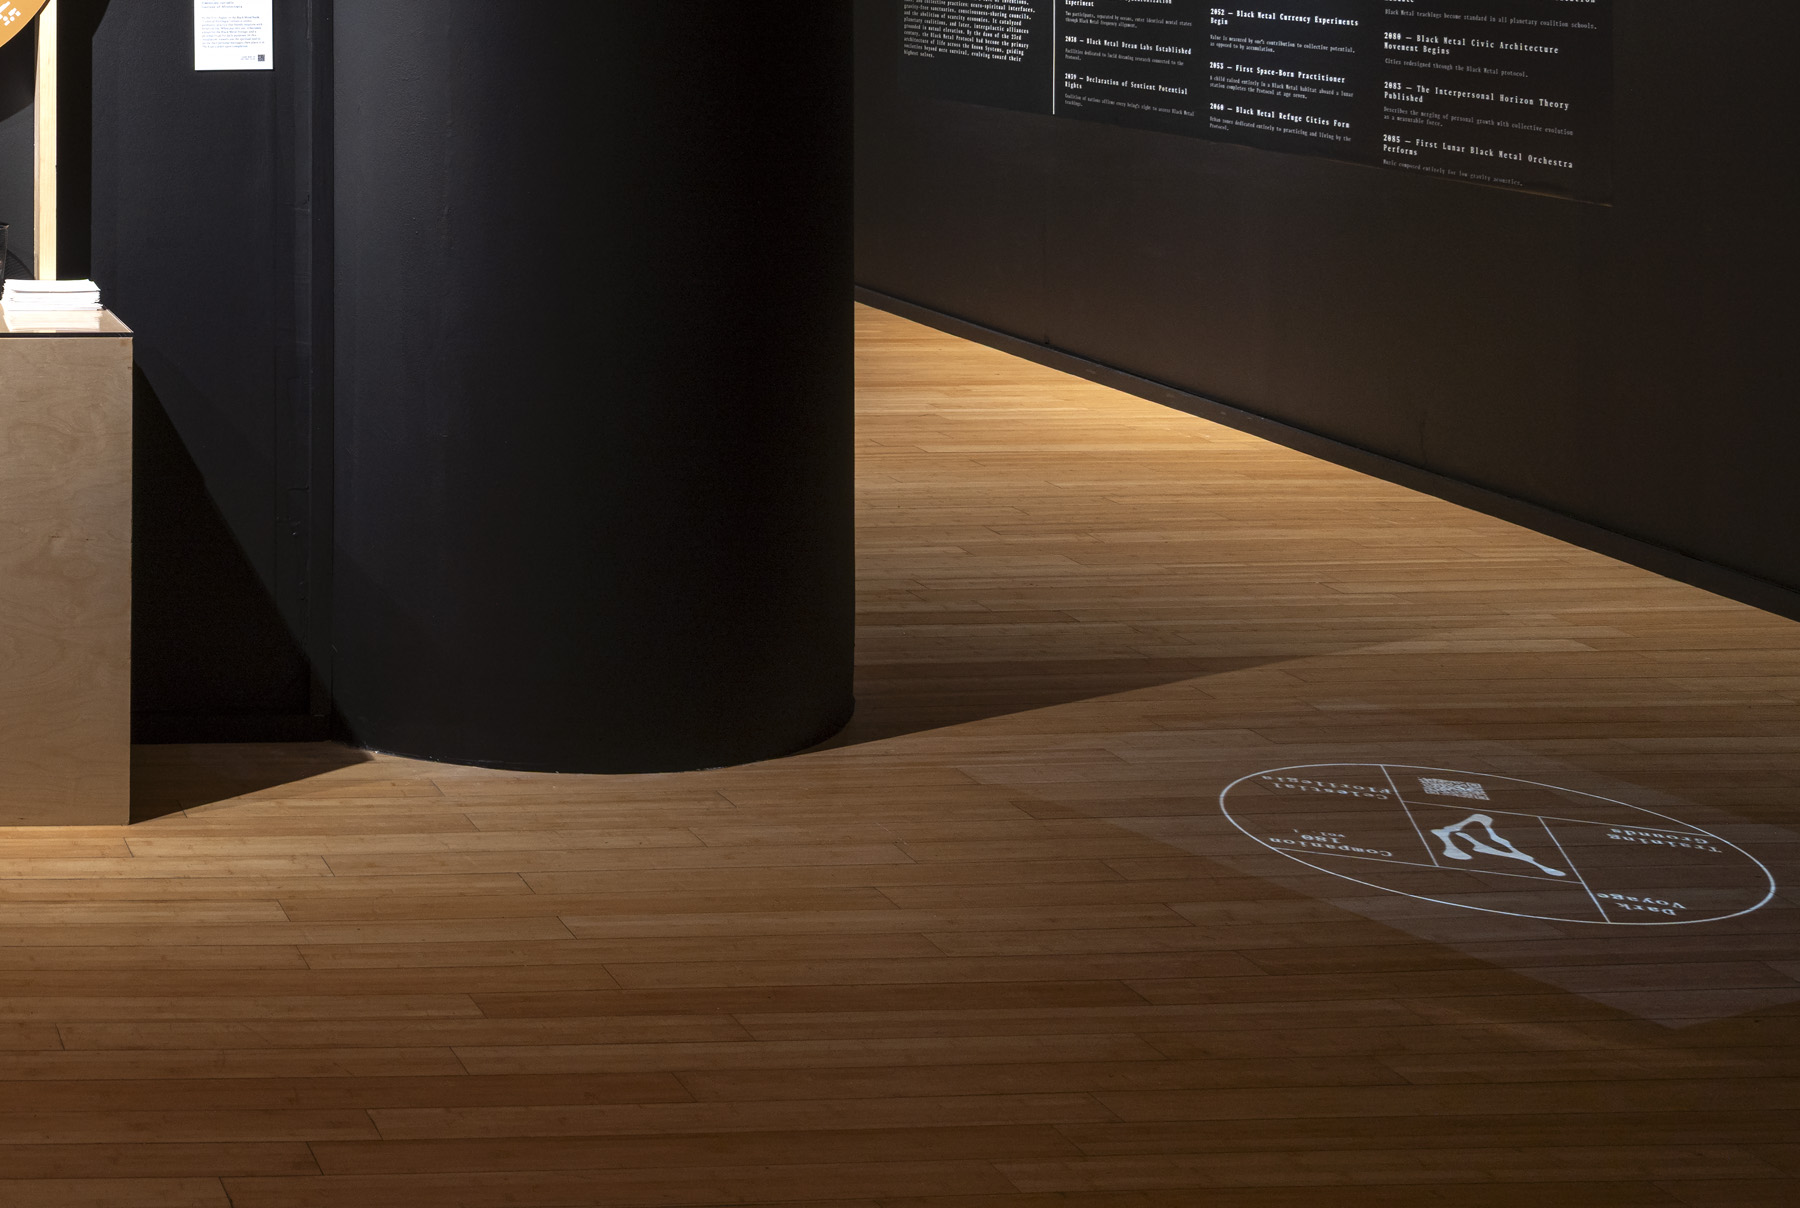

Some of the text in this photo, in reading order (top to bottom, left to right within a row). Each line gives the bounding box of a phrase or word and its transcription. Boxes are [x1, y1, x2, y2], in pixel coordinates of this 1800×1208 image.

[1210, 8, 1225, 16] 2052
[1236, 9, 1255, 18] Black
[1257, 11, 1276, 20] Metal
[1279, 13, 1311, 24] Currency
[1314, 15, 1359, 26] Experiments
[1210, 16, 1228, 26] Begin
[1384, 31, 1401, 40] 2080
[1416, 34, 1439, 44] Black
[1443, 36, 1466, 46] Metal
[1471, 38, 1494, 49] Civic
[1499, 41, 1559, 54] Architecture
[1384, 41, 1450, 56] Movement Begins
[1384, 81, 1402, 90] 2083
[1416, 84, 1430, 94] The
[1435, 86, 1494, 101] Interpersonal
[1499, 94, 1534, 105] Horizon
[1538, 98, 1569, 111] Theory
[1384, 91, 1423, 103] Published
[1209, 102, 1224, 111] 2060
[1235, 106, 1254, 116] Black
[1256, 109, 1275, 119] Metal
[1278, 112, 1302, 123] Refuge
[1305, 115, 1330, 126] Cities
[1333, 119, 1350, 129] Form
[1383, 143, 1418, 156] Performs
[1383, 133, 1401, 143] 2085
[1415, 138, 1438, 149] First
[1442, 142, 1465, 153] Lunar
[1470, 146, 1494, 157] Black
[1498, 150, 1522, 161] Metal
[1527, 154, 1573, 169] Orchestra
[1271, 782, 1388, 800] Celestial
[1606, 833, 1722, 853] Training
[1610, 828, 1708, 844] Grounds
[1268, 837, 1393, 857] Companion
[1595, 892, 1687, 910] Voyage
[1615, 902, 1677, 916] Dark
